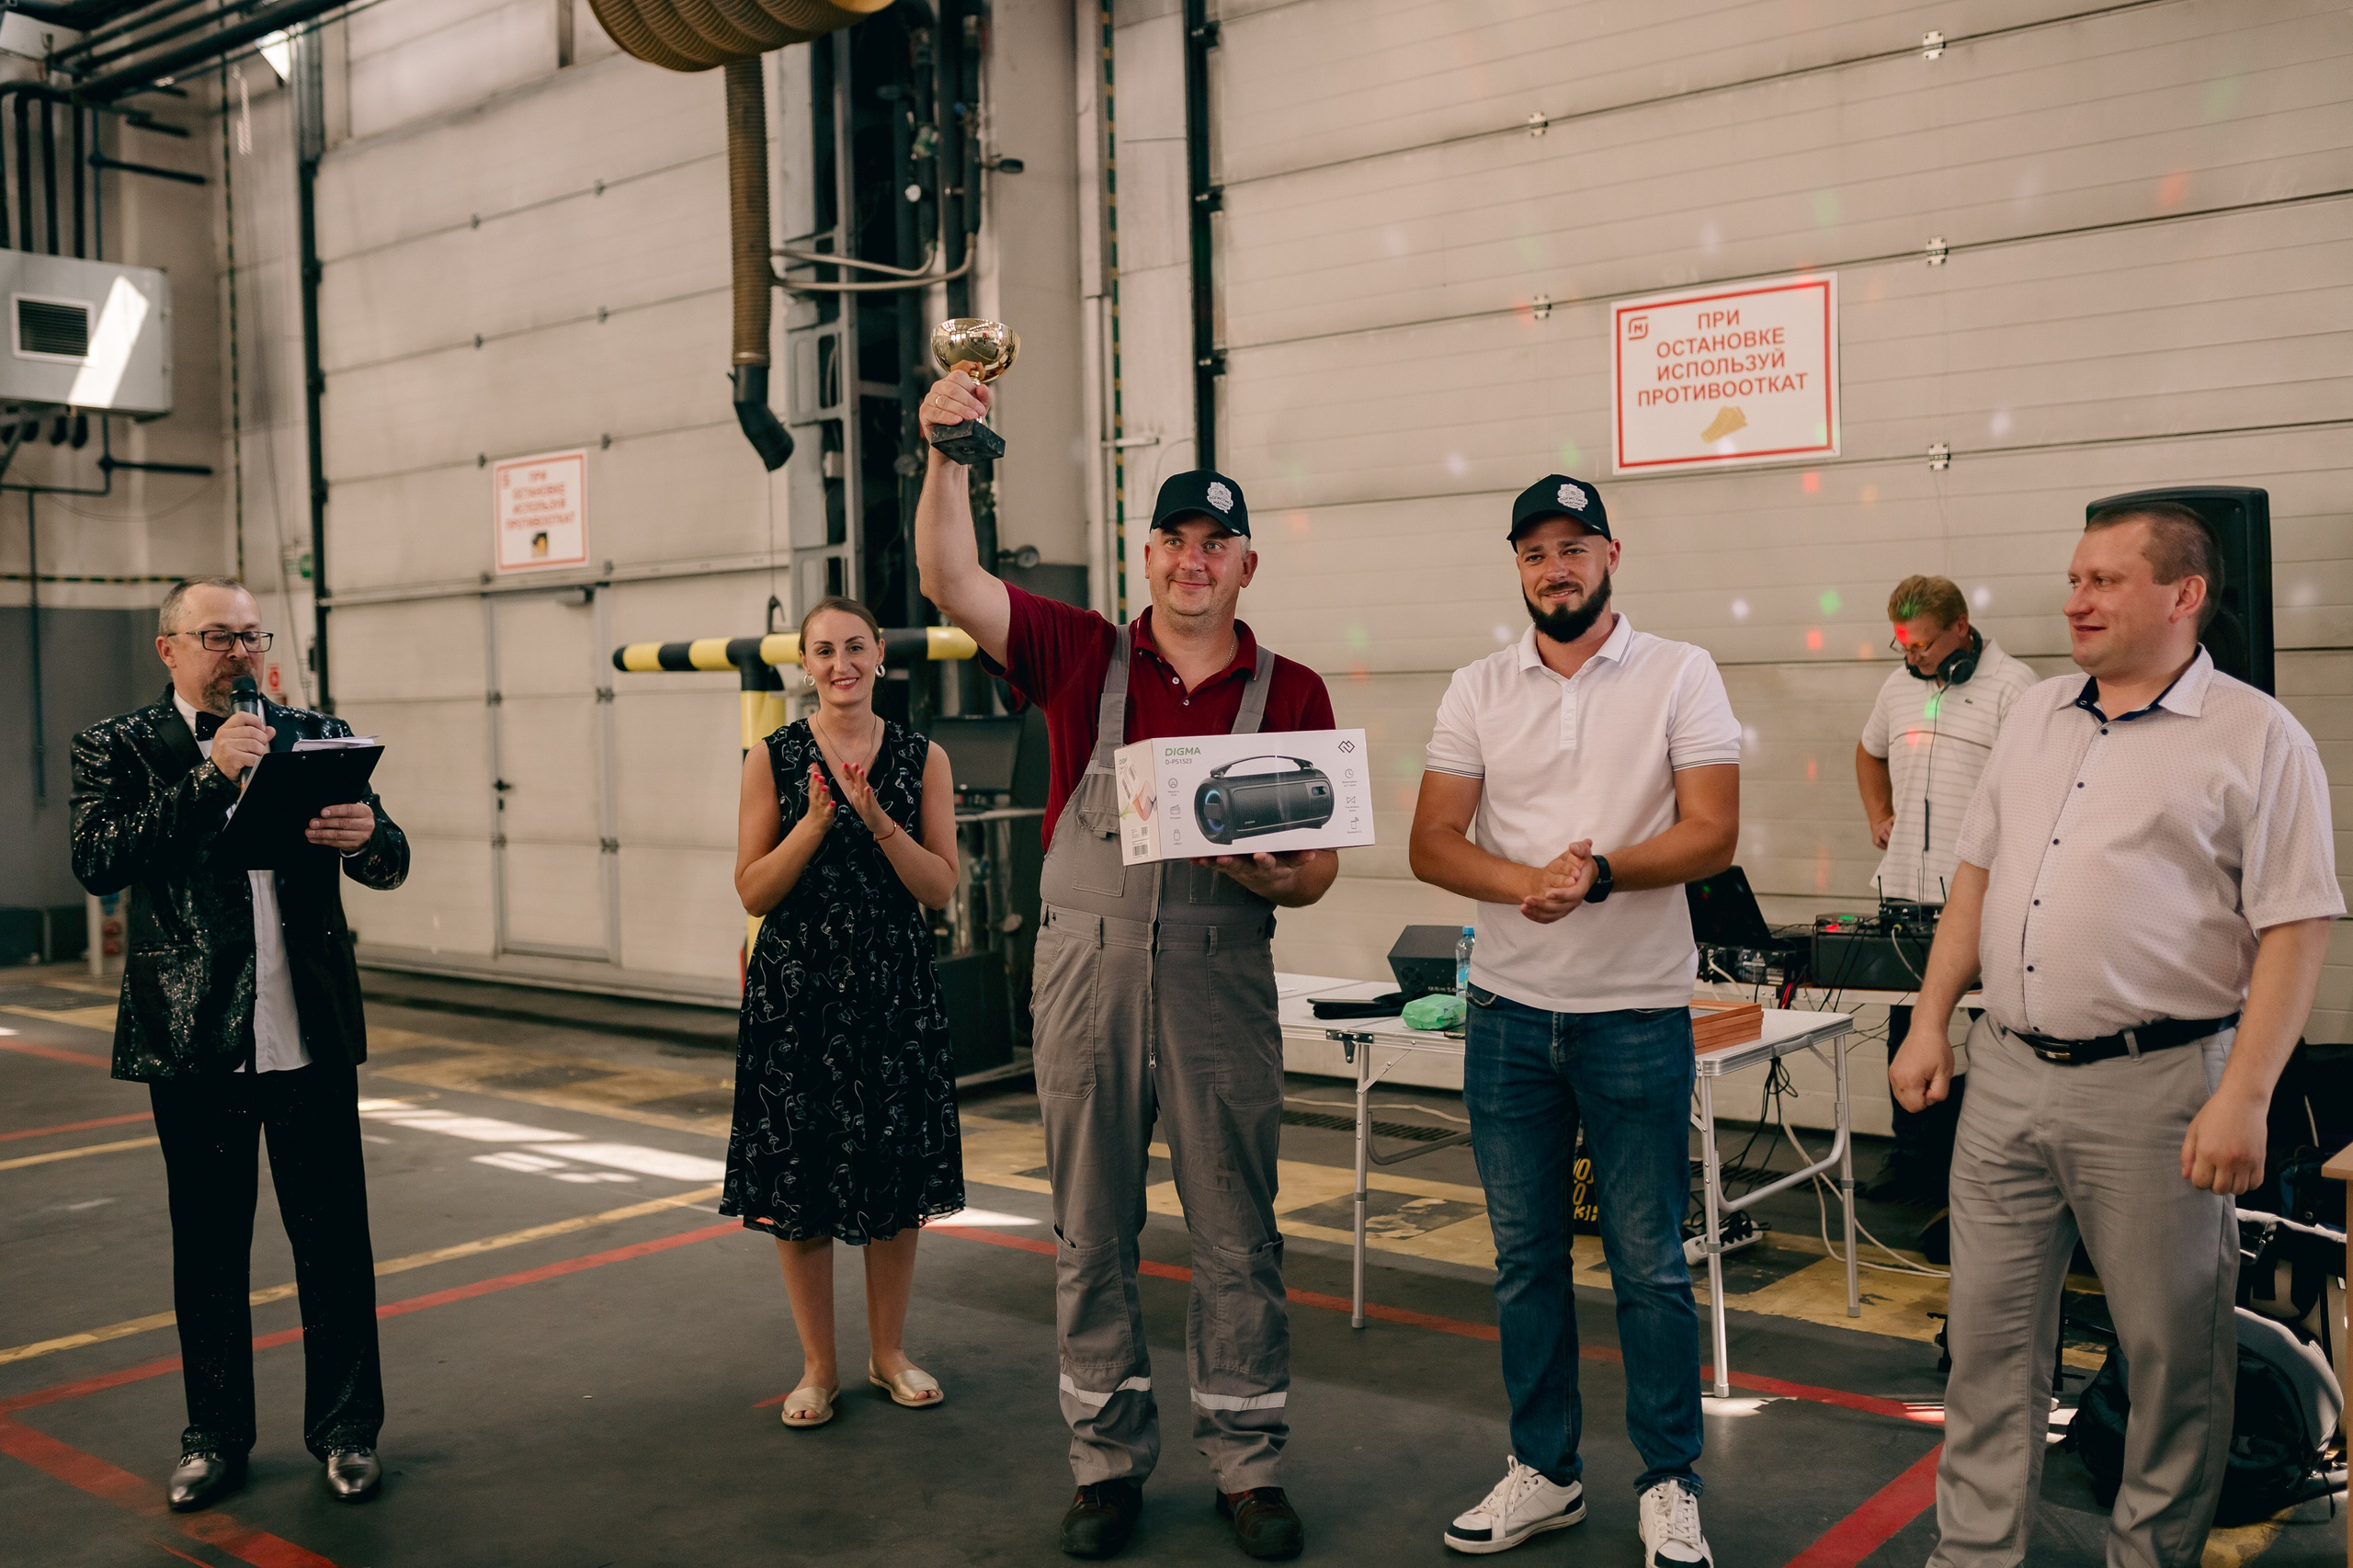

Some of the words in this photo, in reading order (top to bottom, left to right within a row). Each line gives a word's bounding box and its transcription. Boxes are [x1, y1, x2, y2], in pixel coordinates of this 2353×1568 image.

[1697, 309, 1741, 330] ПРИ
[1656, 326, 1785, 358] ОСТАНОВКЕ
[1656, 347, 1785, 381] ИСПОЛЬЗУЙ
[1638, 372, 1808, 407] ПРОТИВООТКАТ
[1165, 746, 1201, 756] DIGMA
[1165, 757, 1193, 766] D-PS1523
